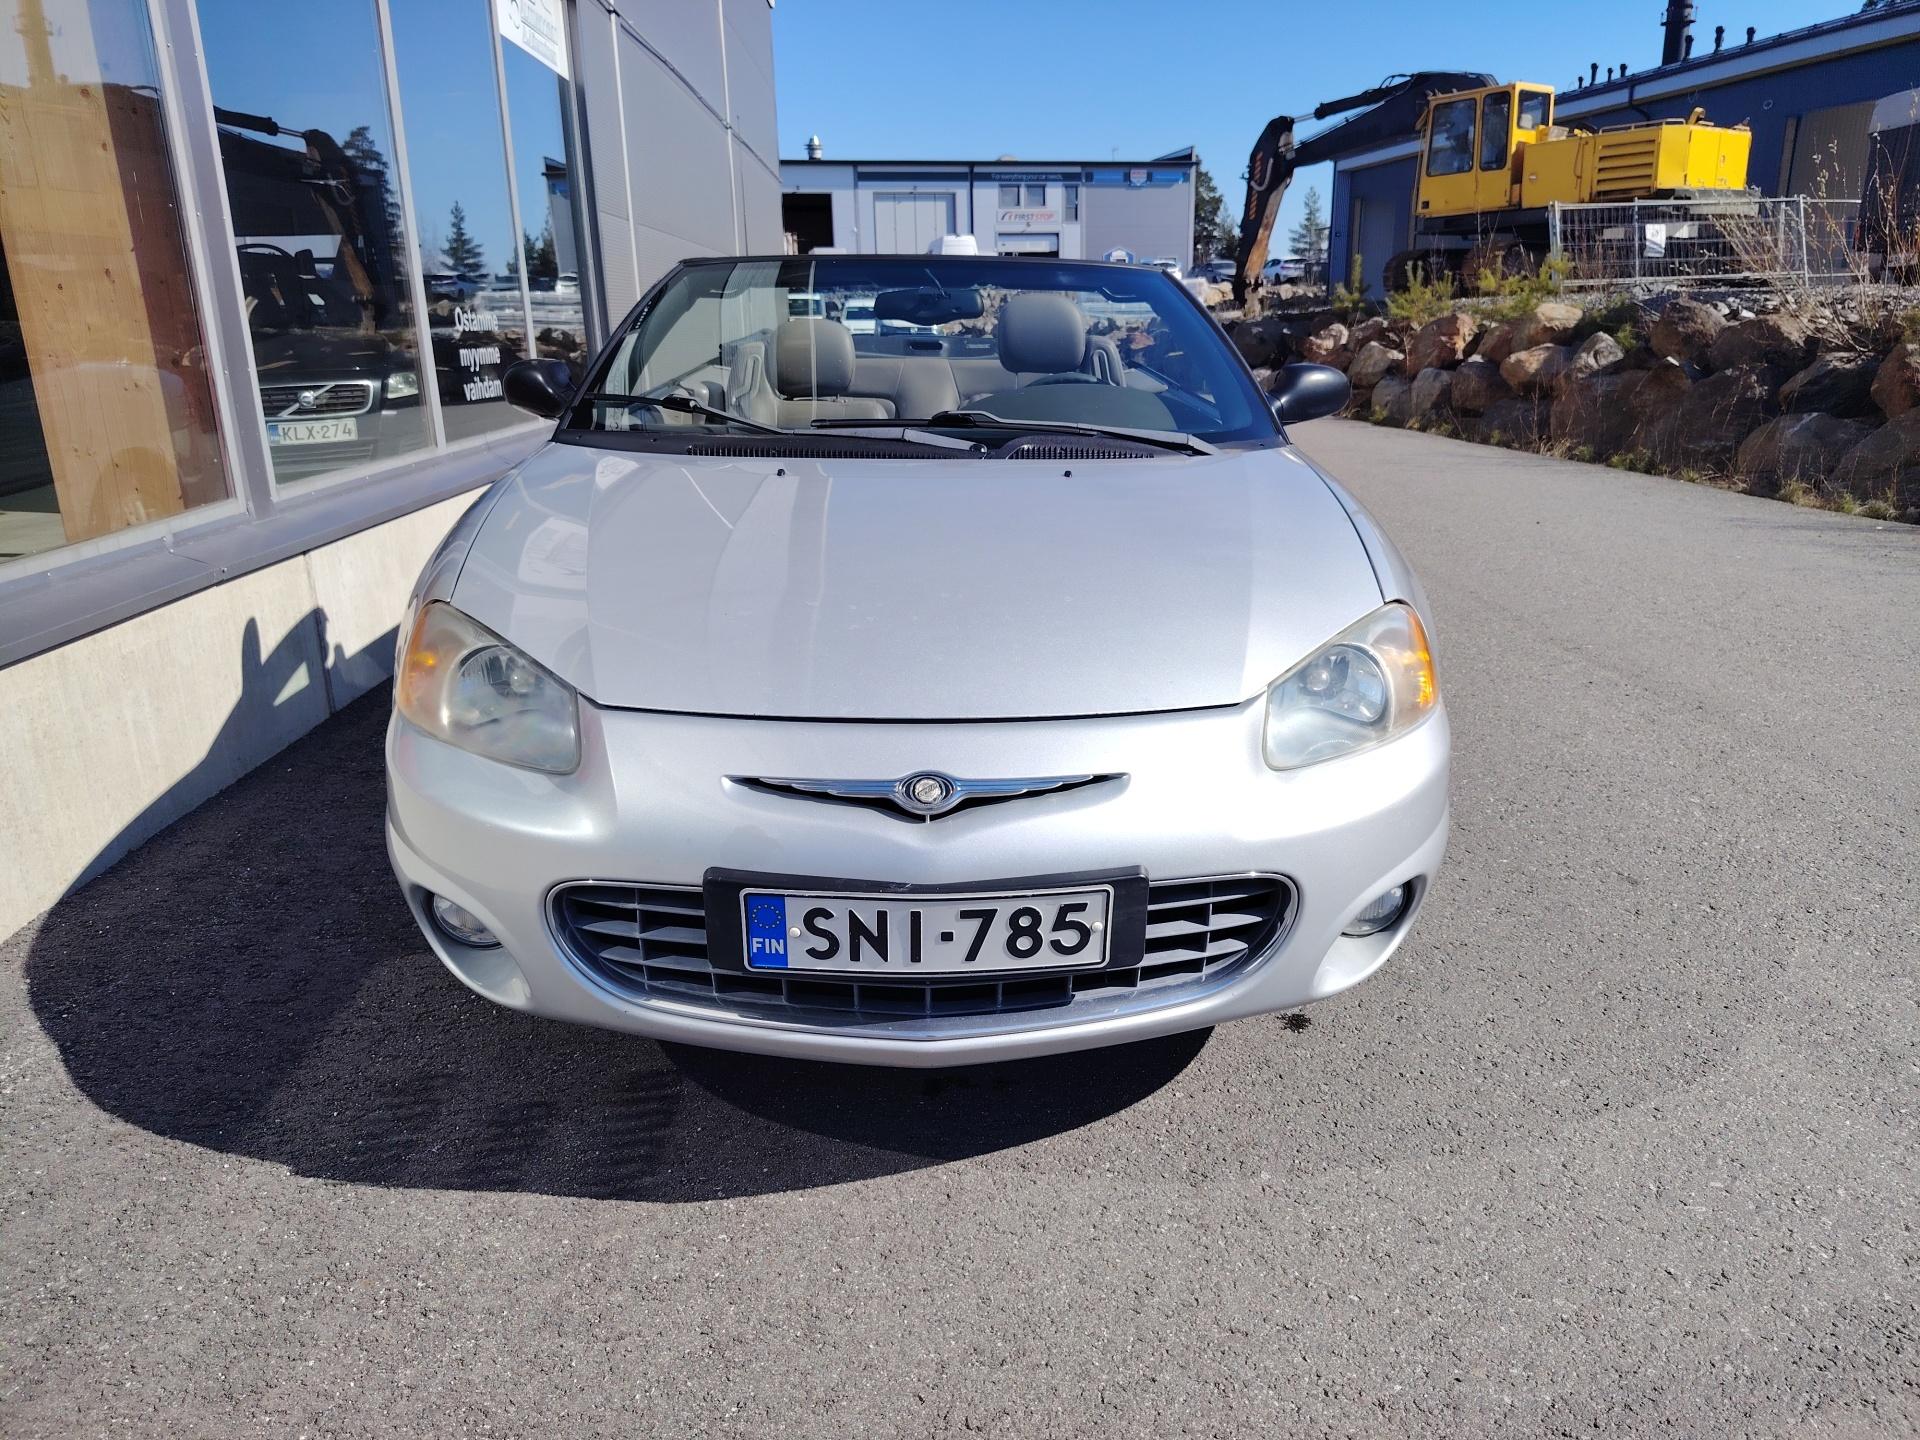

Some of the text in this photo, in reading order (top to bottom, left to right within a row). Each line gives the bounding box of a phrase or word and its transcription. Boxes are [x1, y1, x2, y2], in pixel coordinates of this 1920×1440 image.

[454, 306, 499, 331] Ostamme
[459, 346, 501, 372] myymme
[463, 375, 503, 401] vaihdam
[282, 423, 352, 440] KLX-274
[802, 902, 1091, 962] SNI-785
[752, 937, 785, 954] FIN
